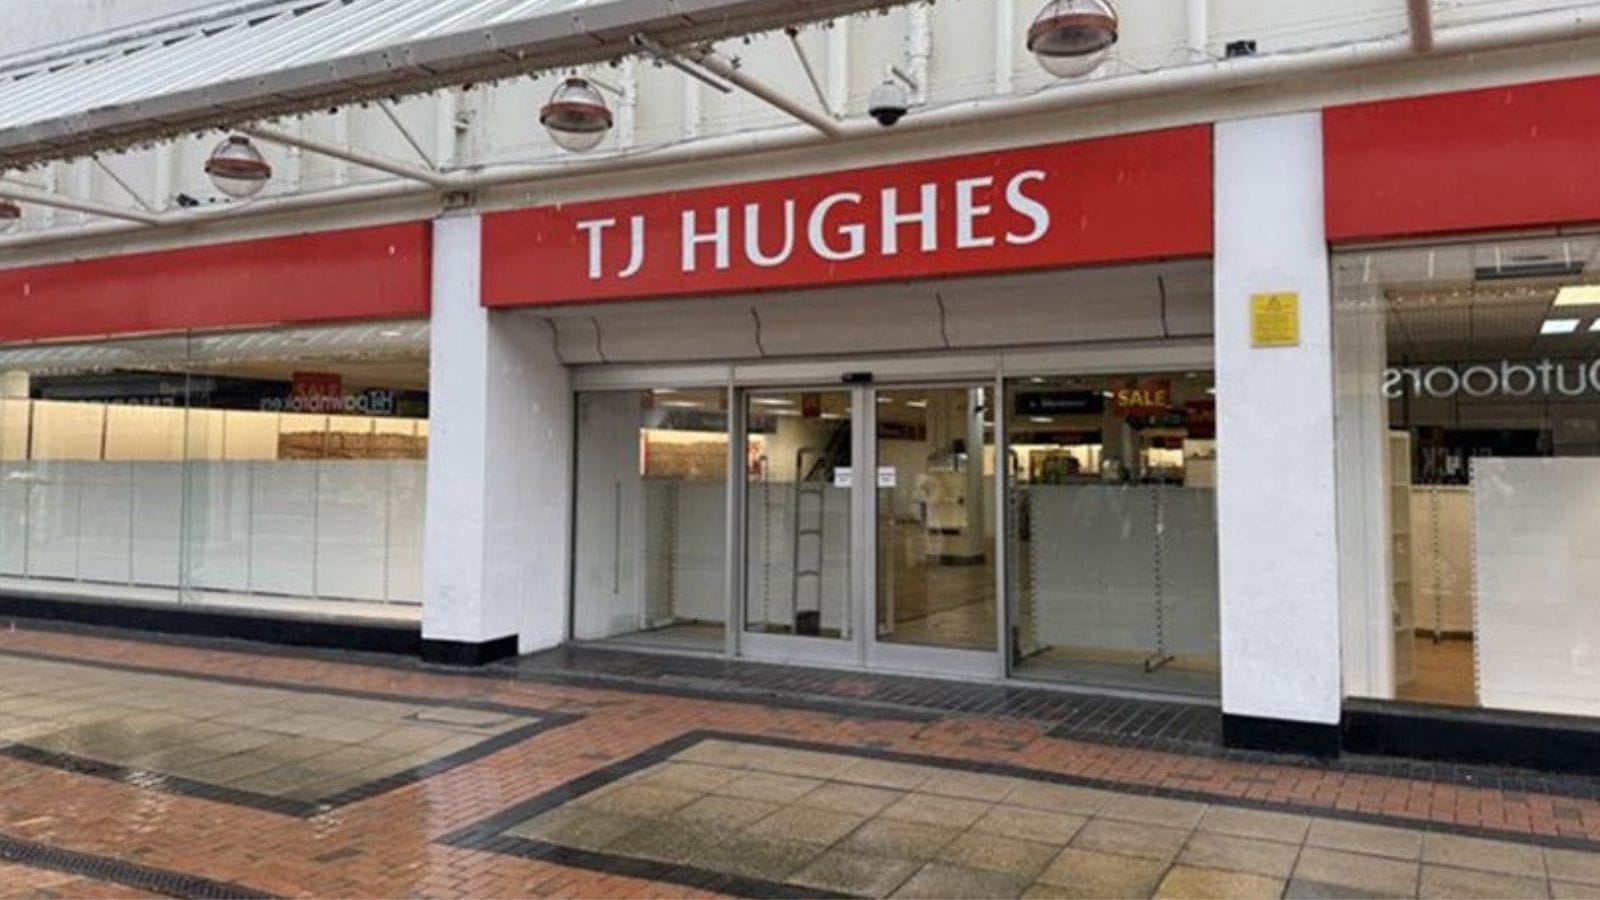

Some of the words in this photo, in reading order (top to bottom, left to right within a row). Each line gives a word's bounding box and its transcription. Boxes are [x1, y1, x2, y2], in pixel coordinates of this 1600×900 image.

[576, 215, 645, 279] TJ
[681, 170, 1050, 272] HUGHES
[1117, 389, 1166, 406] SALE
